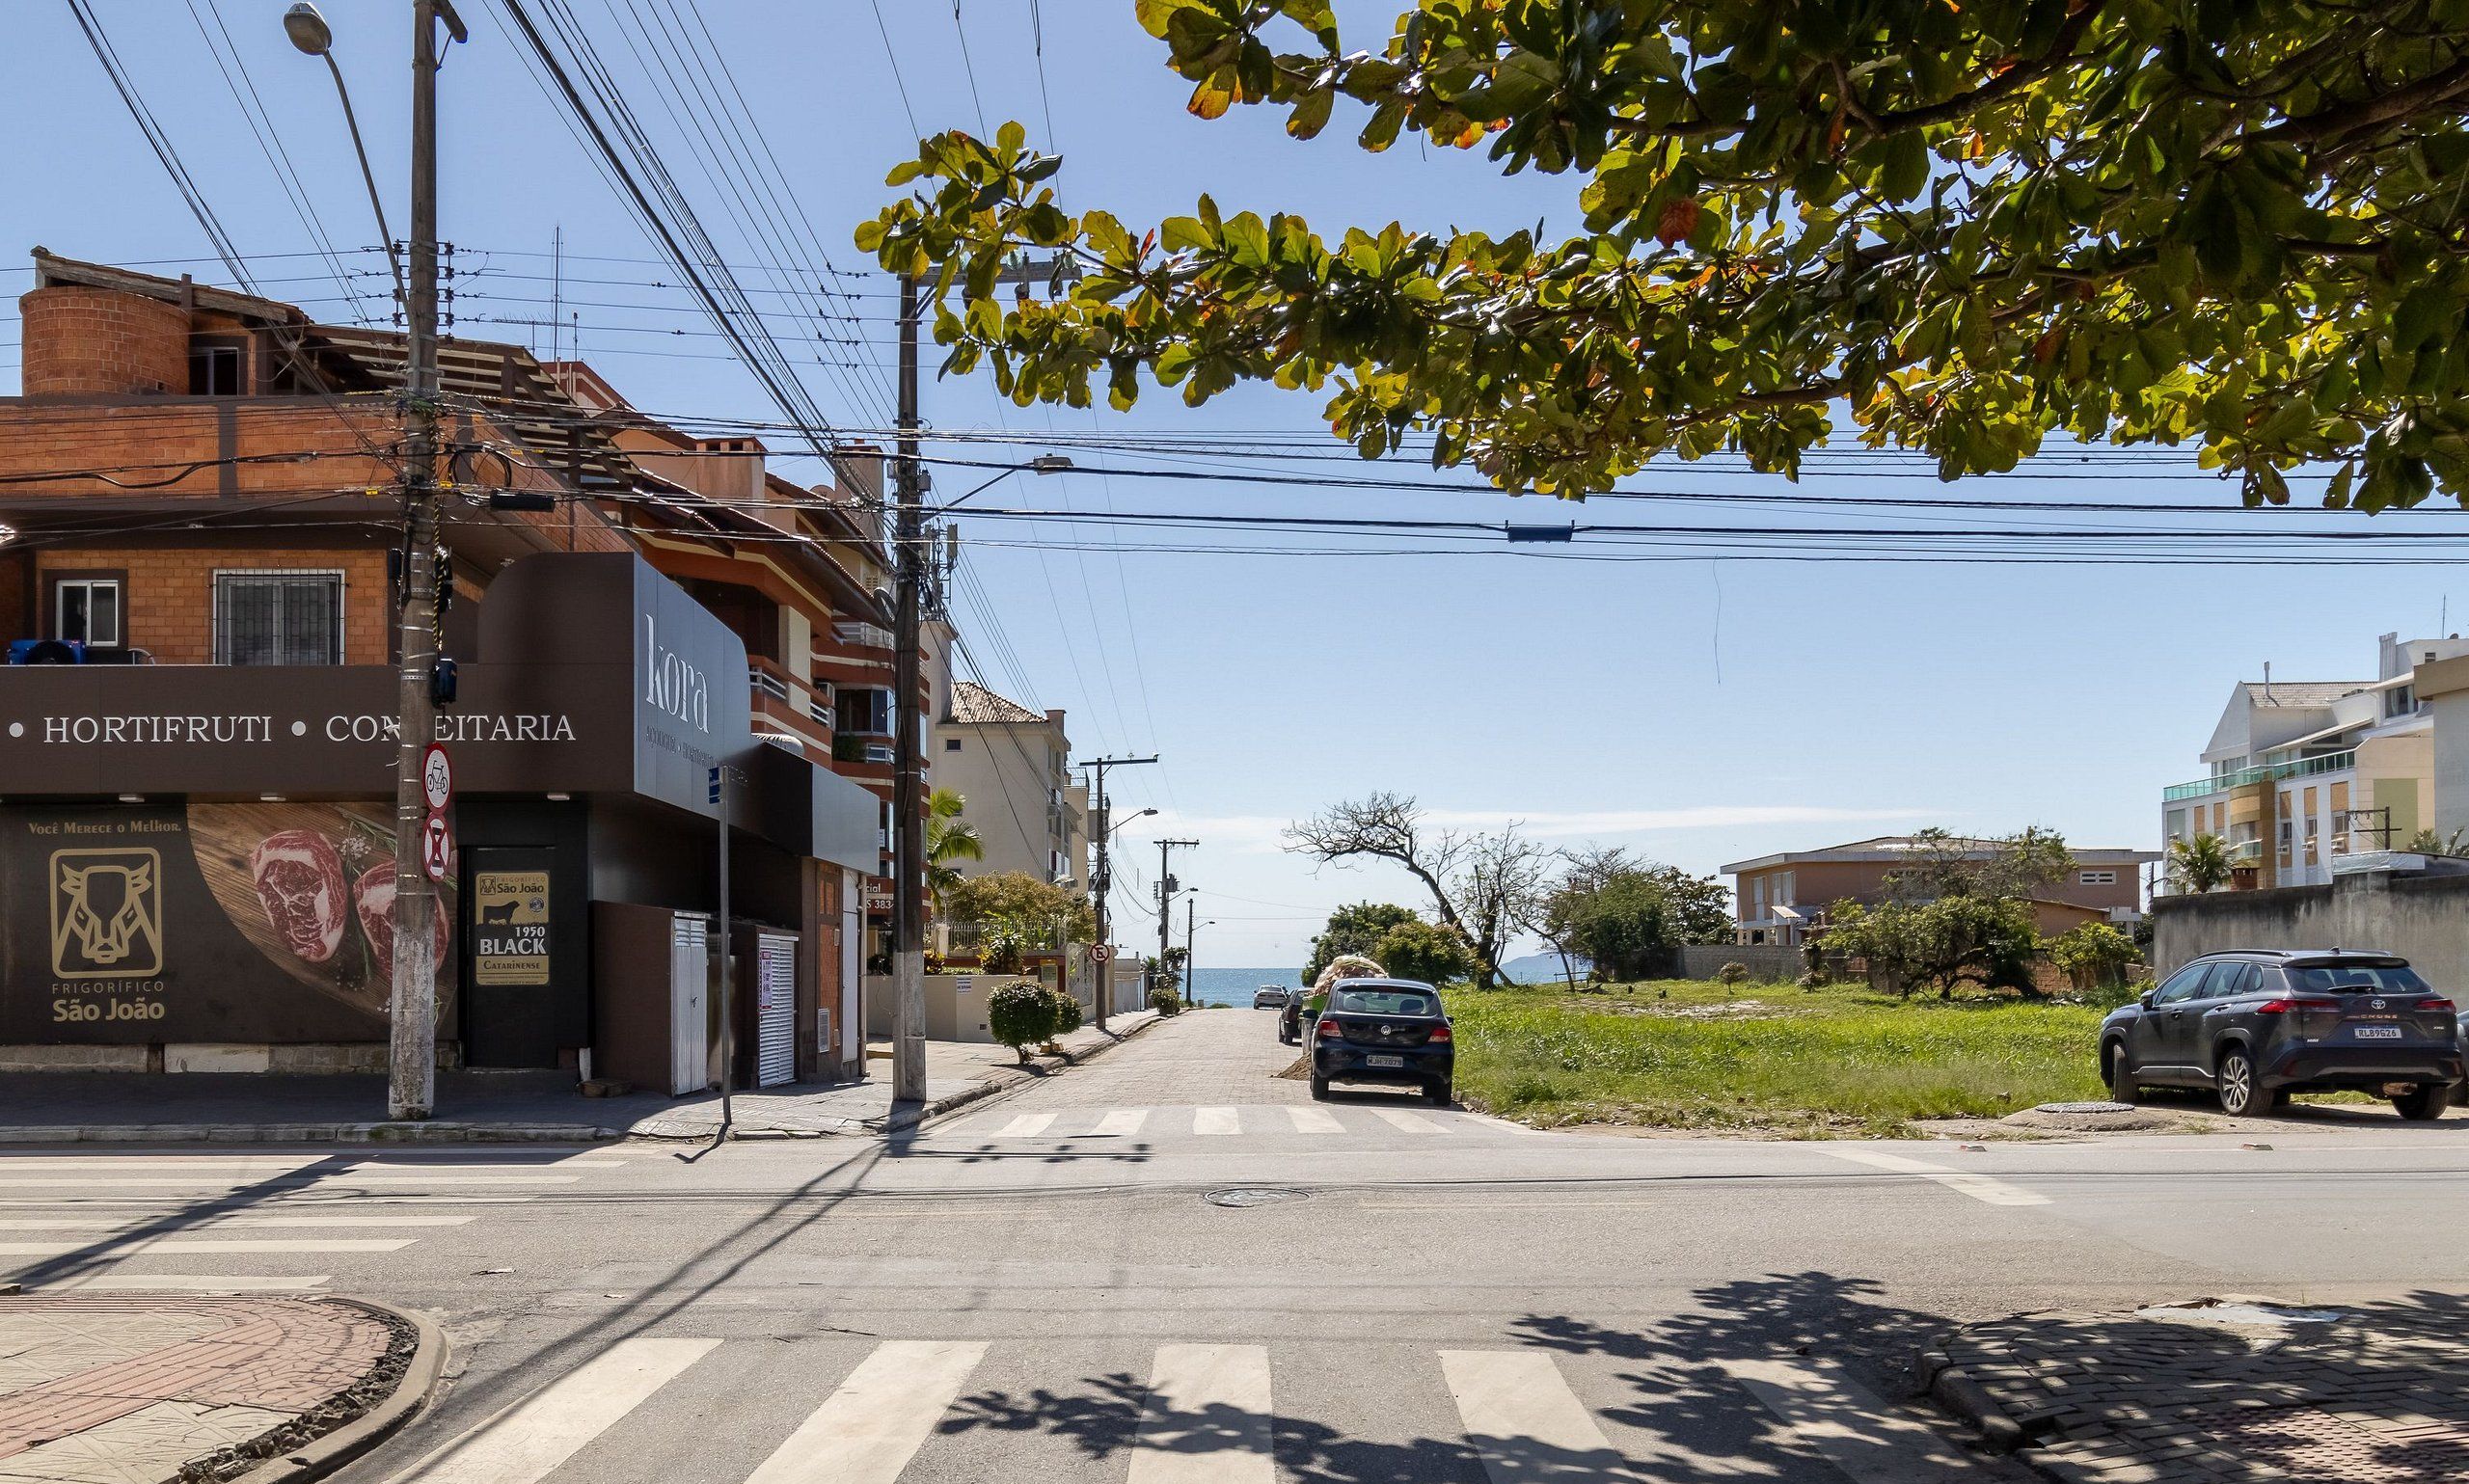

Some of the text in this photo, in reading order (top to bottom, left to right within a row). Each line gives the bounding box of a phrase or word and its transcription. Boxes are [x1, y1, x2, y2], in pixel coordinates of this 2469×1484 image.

[644, 613, 711, 735] kora
[42, 715, 577, 743] HORTIFRUTI CONEITARIA
[497, 882, 545, 894] São João
[515, 926, 546, 937] 1950
[479, 938, 547, 955] BLACK
[51, 980, 165, 995] FRIGORÍFICO
[52, 996, 165, 1022] São João
